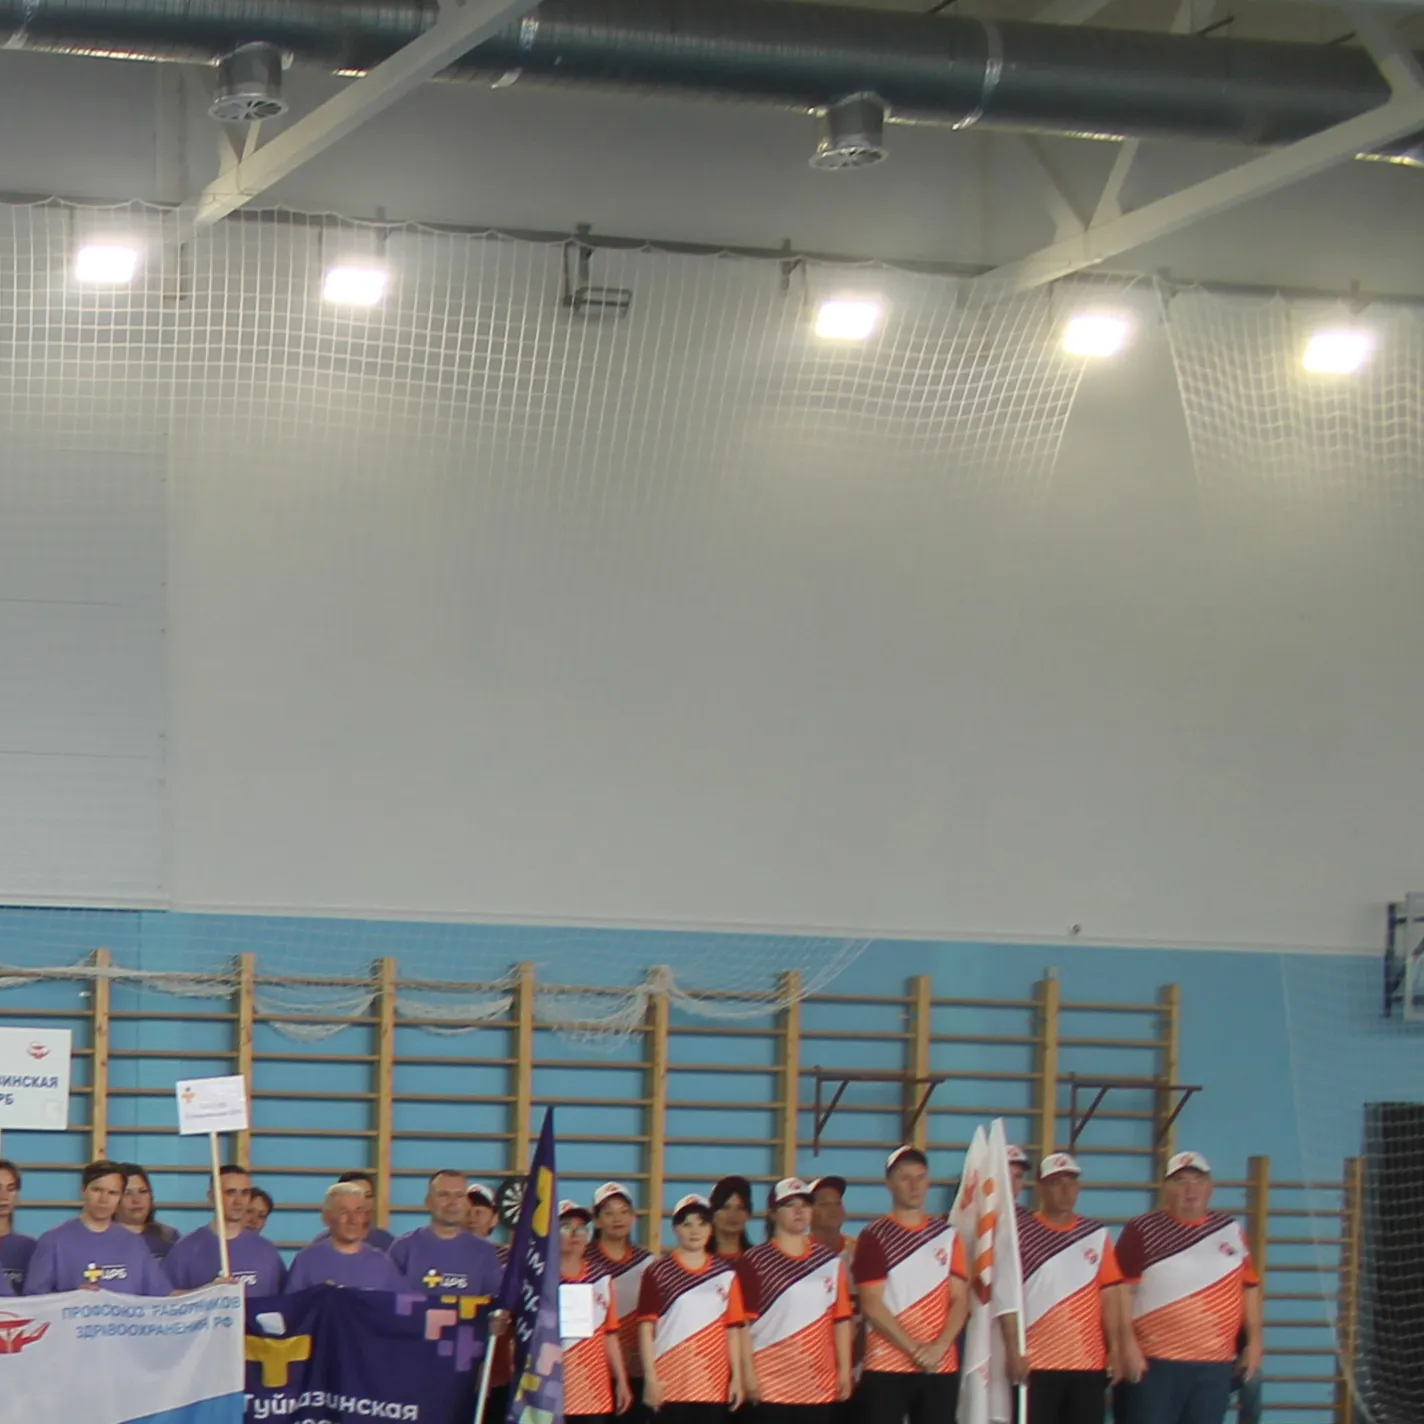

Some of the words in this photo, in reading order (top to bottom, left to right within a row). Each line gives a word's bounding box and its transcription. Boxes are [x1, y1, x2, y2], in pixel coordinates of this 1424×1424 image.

[62, 1304, 145, 1320] ПРОФСОЮЗ
[152, 1296, 241, 1317] РАБОТНИКОВ
[75, 1317, 208, 1340] ЗДРАВООХРАНЕНИЯ
[214, 1316, 234, 1329] РФ
